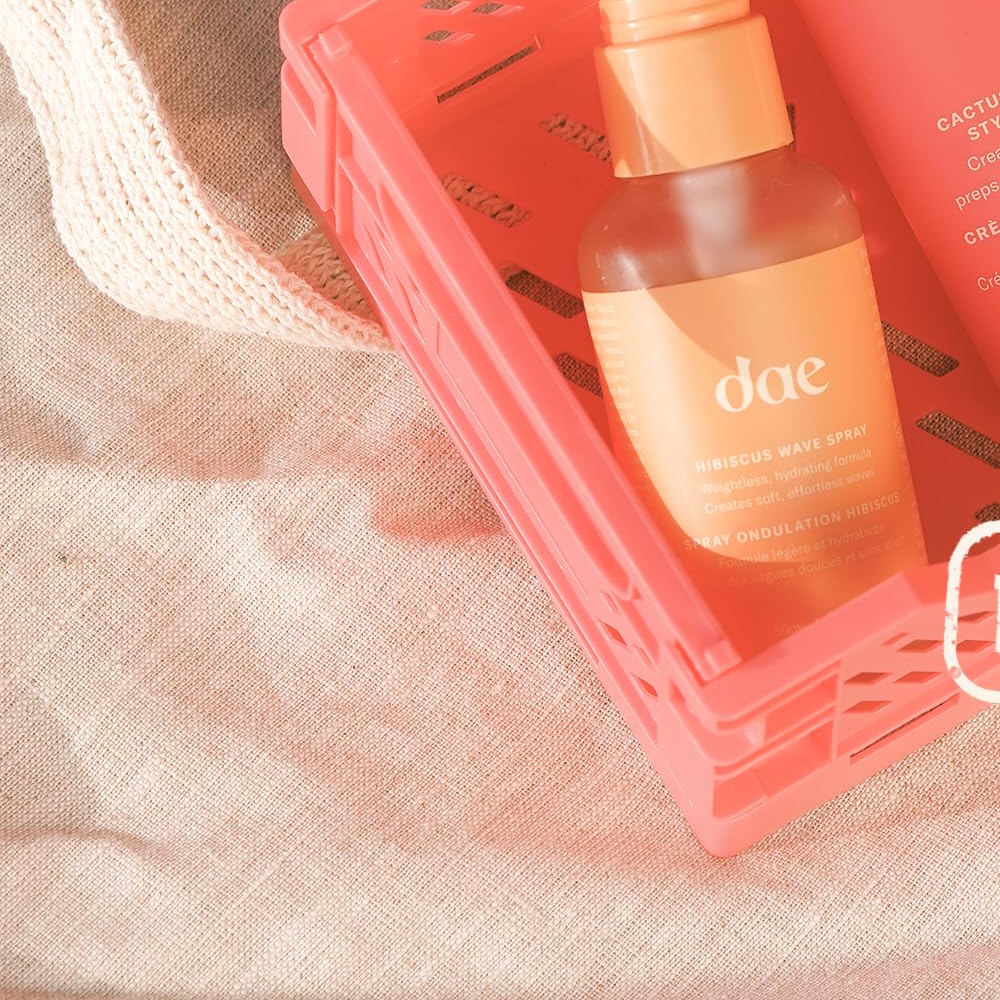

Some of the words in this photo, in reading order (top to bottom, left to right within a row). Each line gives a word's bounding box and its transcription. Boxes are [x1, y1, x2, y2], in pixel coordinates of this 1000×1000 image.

[955, 184, 1000, 210] preps
[714, 355, 830, 413] dae
[695, 449, 773, 473] HIBISCUS
[778, 438, 822, 458] WAVE
[827, 423, 868, 446] SPRAY
[700, 474, 772, 496] Weightless,
[775, 459, 833, 483] hydrating
[834, 447, 873, 467] formula
[705, 498, 752, 515] Creates
[787, 477, 843, 499] effortless
[684, 534, 731, 551] SPRAY
[736, 511, 842, 545] ONDULATION
[847, 491, 901, 520] HIBISCUS
